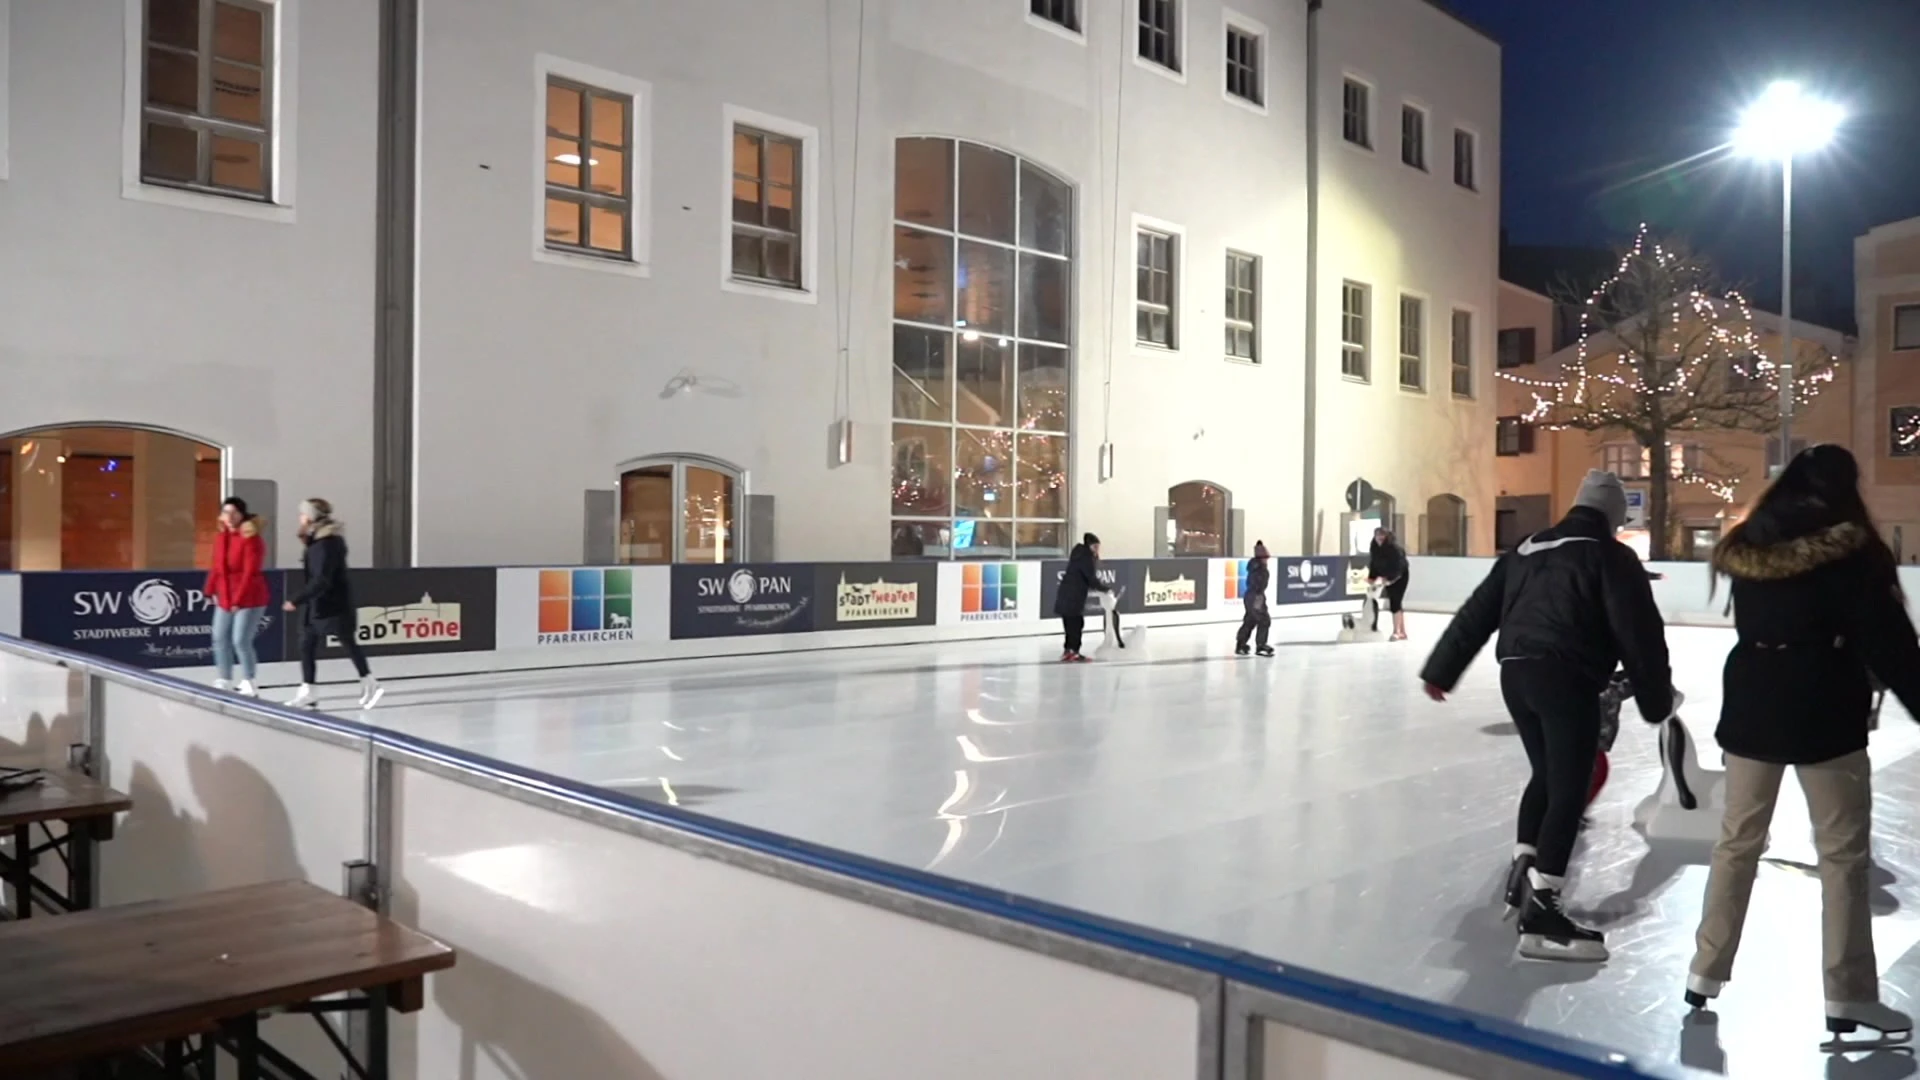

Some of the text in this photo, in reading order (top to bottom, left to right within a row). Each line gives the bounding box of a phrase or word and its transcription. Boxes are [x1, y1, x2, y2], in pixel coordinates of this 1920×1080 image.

[697, 576, 792, 597] SW PAN
[73, 589, 218, 616] SW PA
[73, 624, 213, 641] STADTWERKE PFARRKIR
[537, 629, 634, 645] PFARRKIRCHEN
